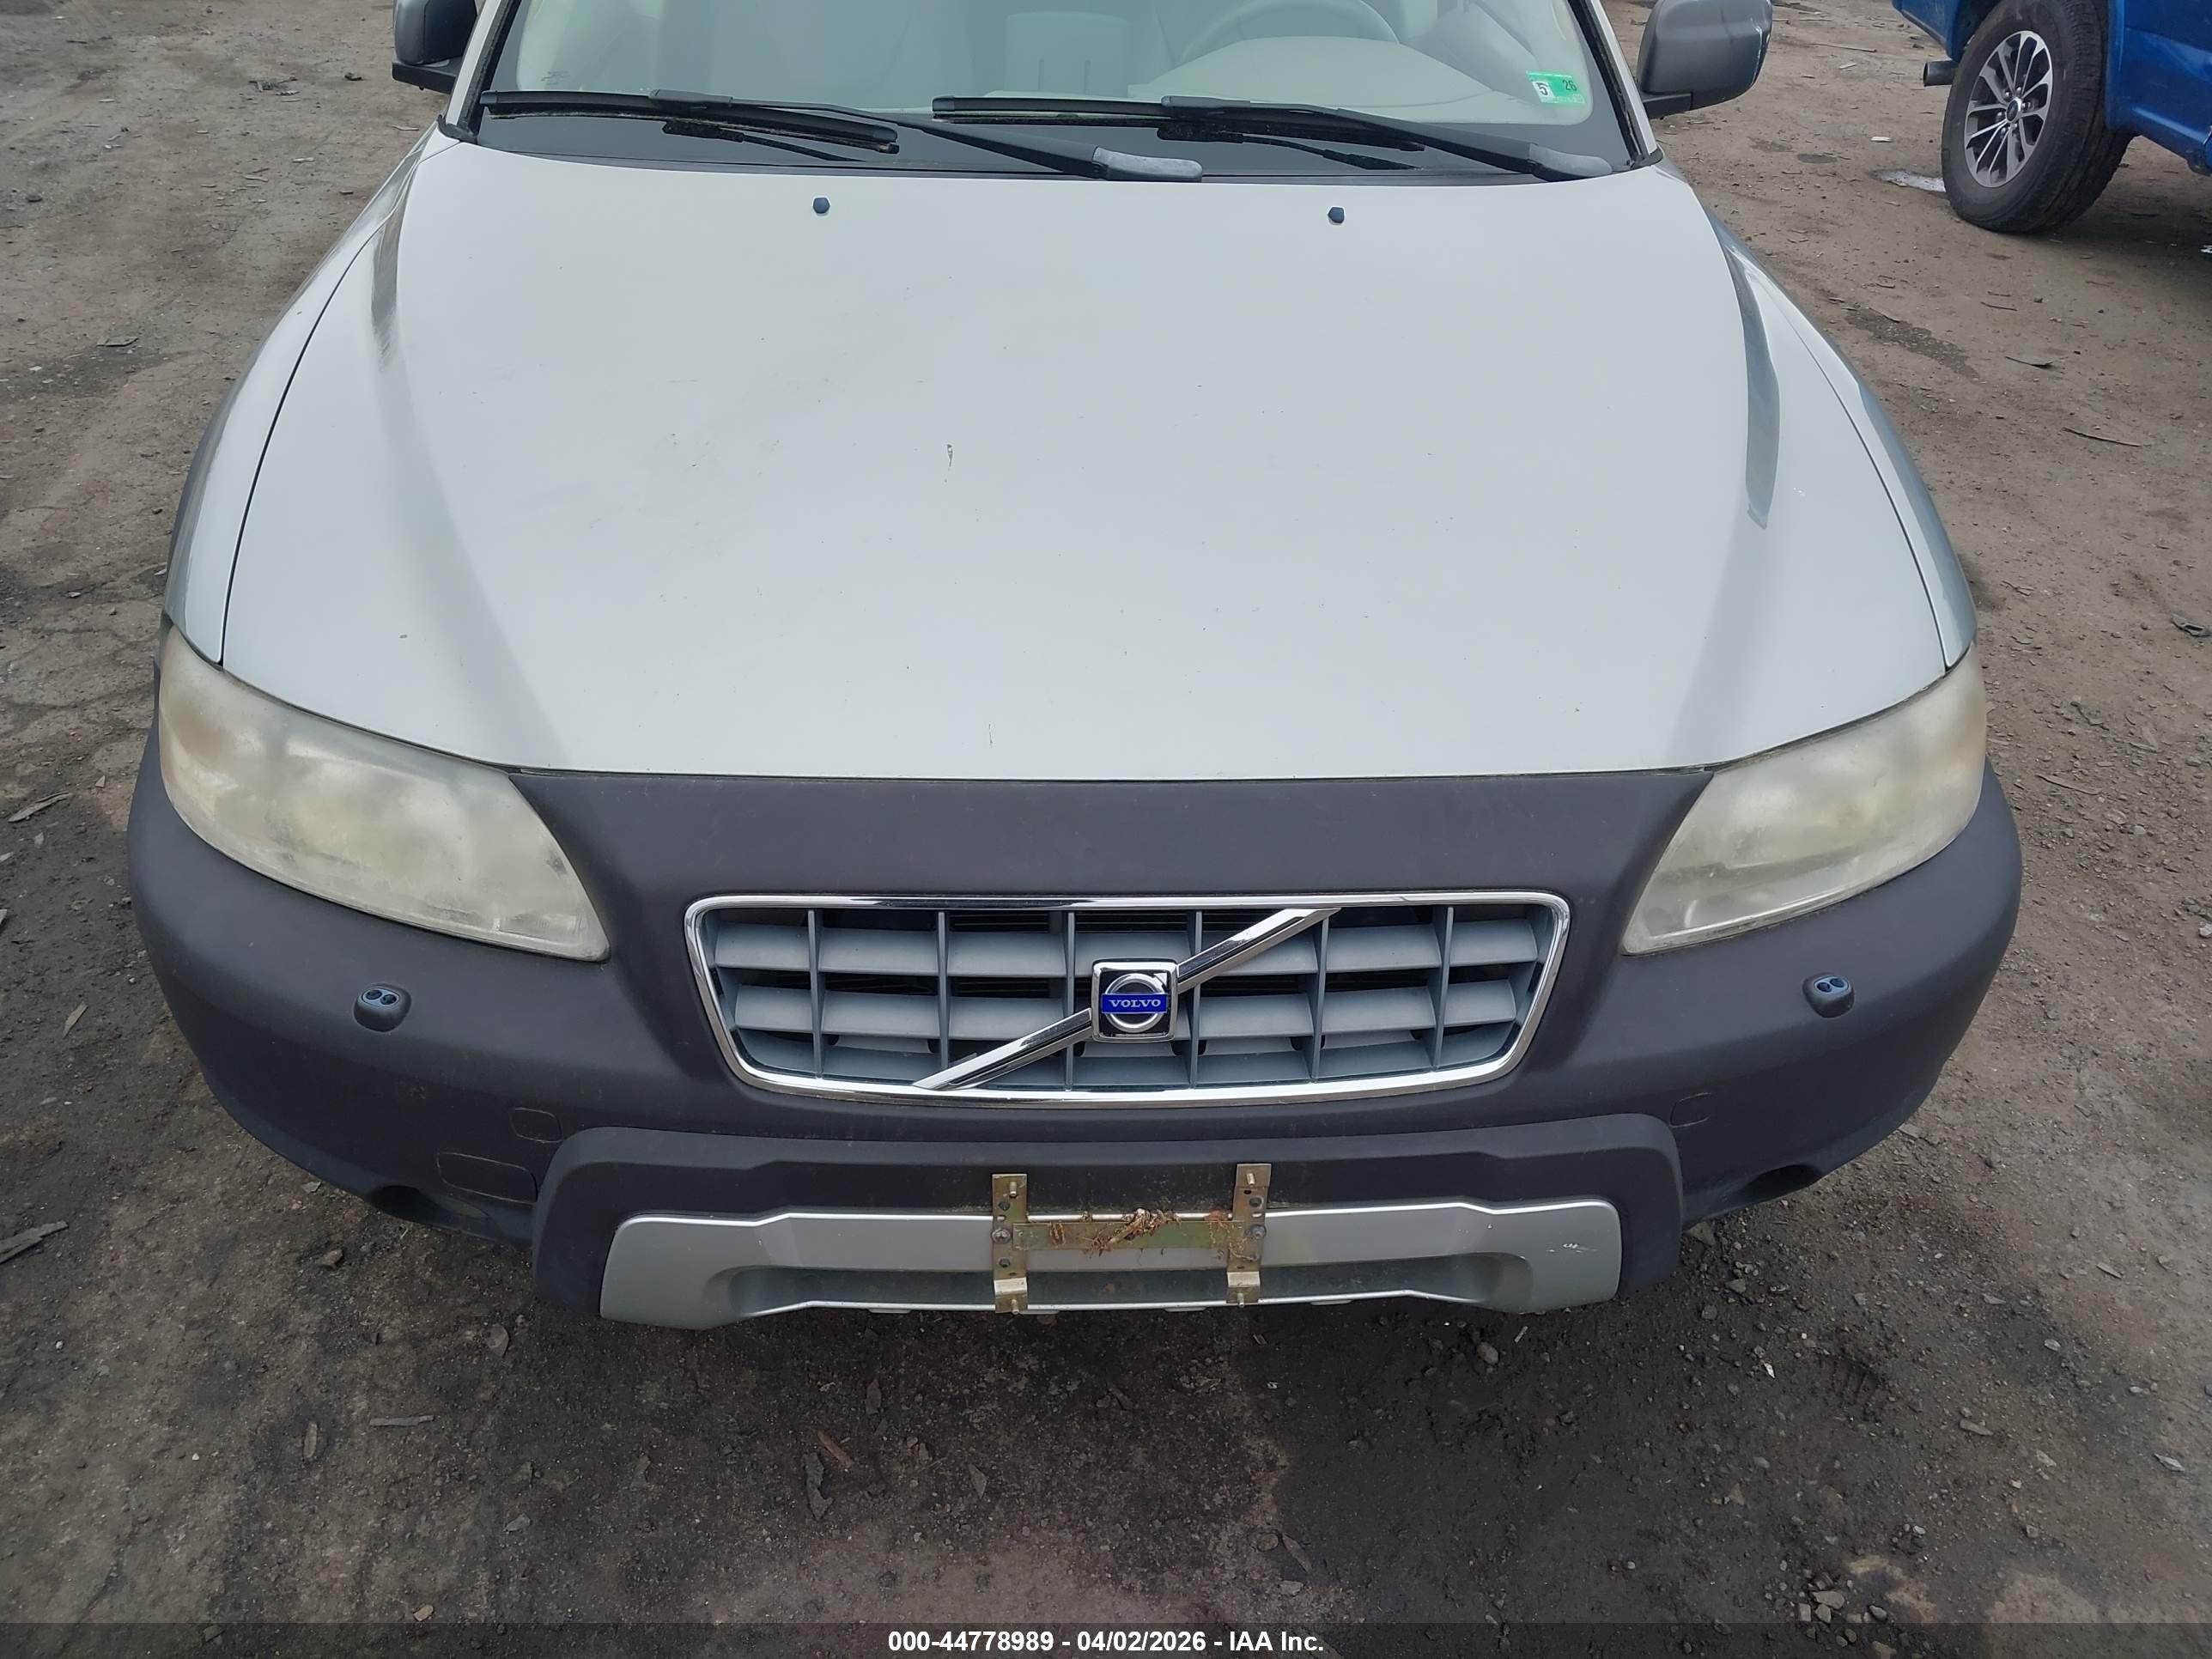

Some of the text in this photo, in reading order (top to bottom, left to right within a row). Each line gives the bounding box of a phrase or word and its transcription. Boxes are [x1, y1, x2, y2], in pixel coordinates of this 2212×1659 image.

[1535, 79, 1577, 95] 5 26
[1109, 999, 1162, 1008] VOLVO
